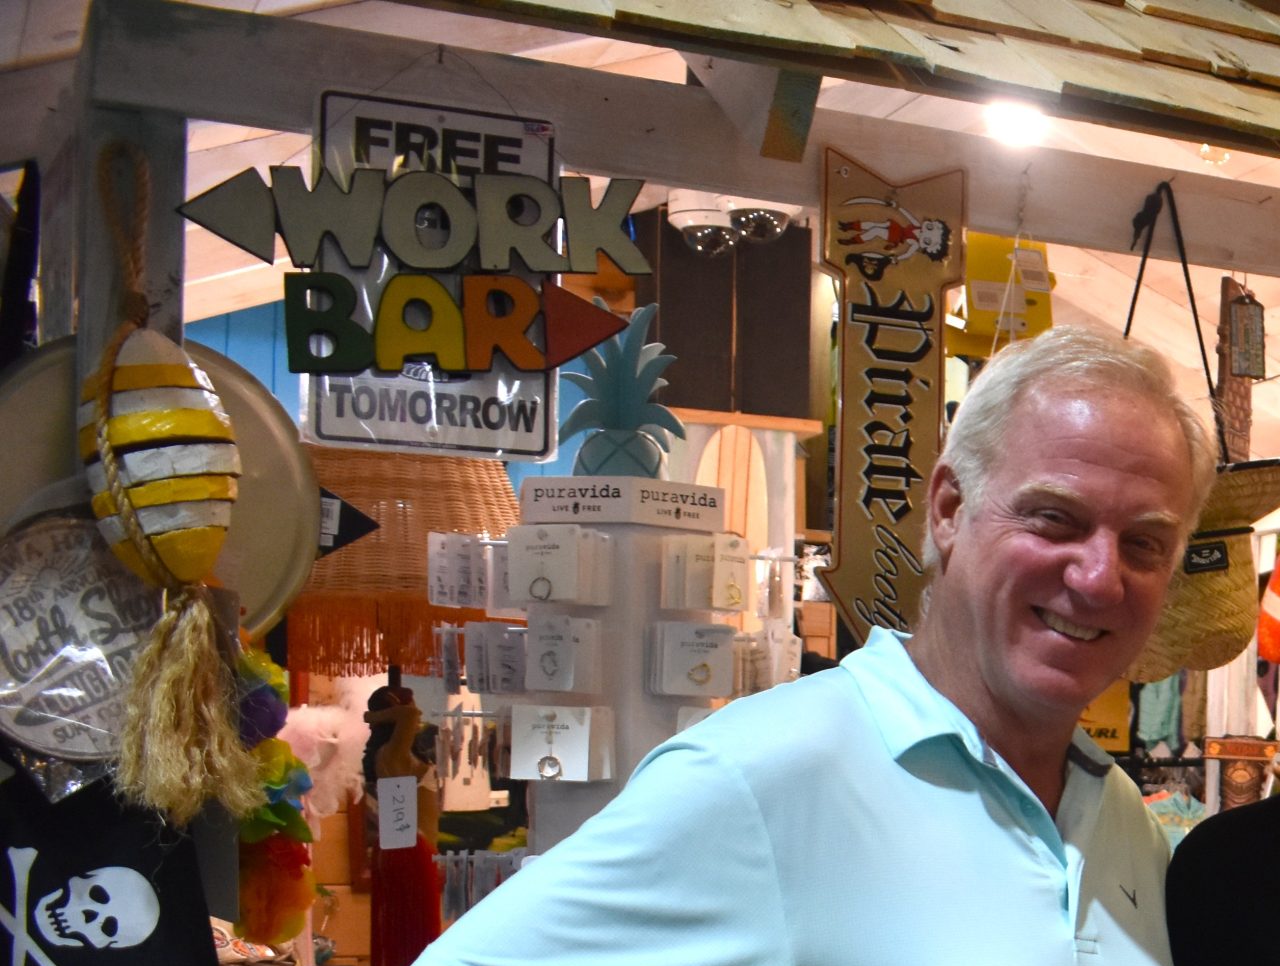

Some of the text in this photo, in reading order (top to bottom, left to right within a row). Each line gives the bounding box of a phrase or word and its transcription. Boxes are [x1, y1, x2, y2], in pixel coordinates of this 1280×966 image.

[355, 116, 523, 175] FREE
[269, 165, 652, 275] WORK
[284, 272, 547, 373] BAR
[329, 383, 538, 433] TOMORROW
[848, 282, 935, 523] Pirate
[533, 485, 622, 501] puravida
[552, 505, 601, 513] LIVE FREE
[640, 487, 717, 509] puravida
[656, 508, 700, 519] LIVE FREE
[40, 651, 134, 718] LONGBO
[1082, 727, 1121, 738] URL
